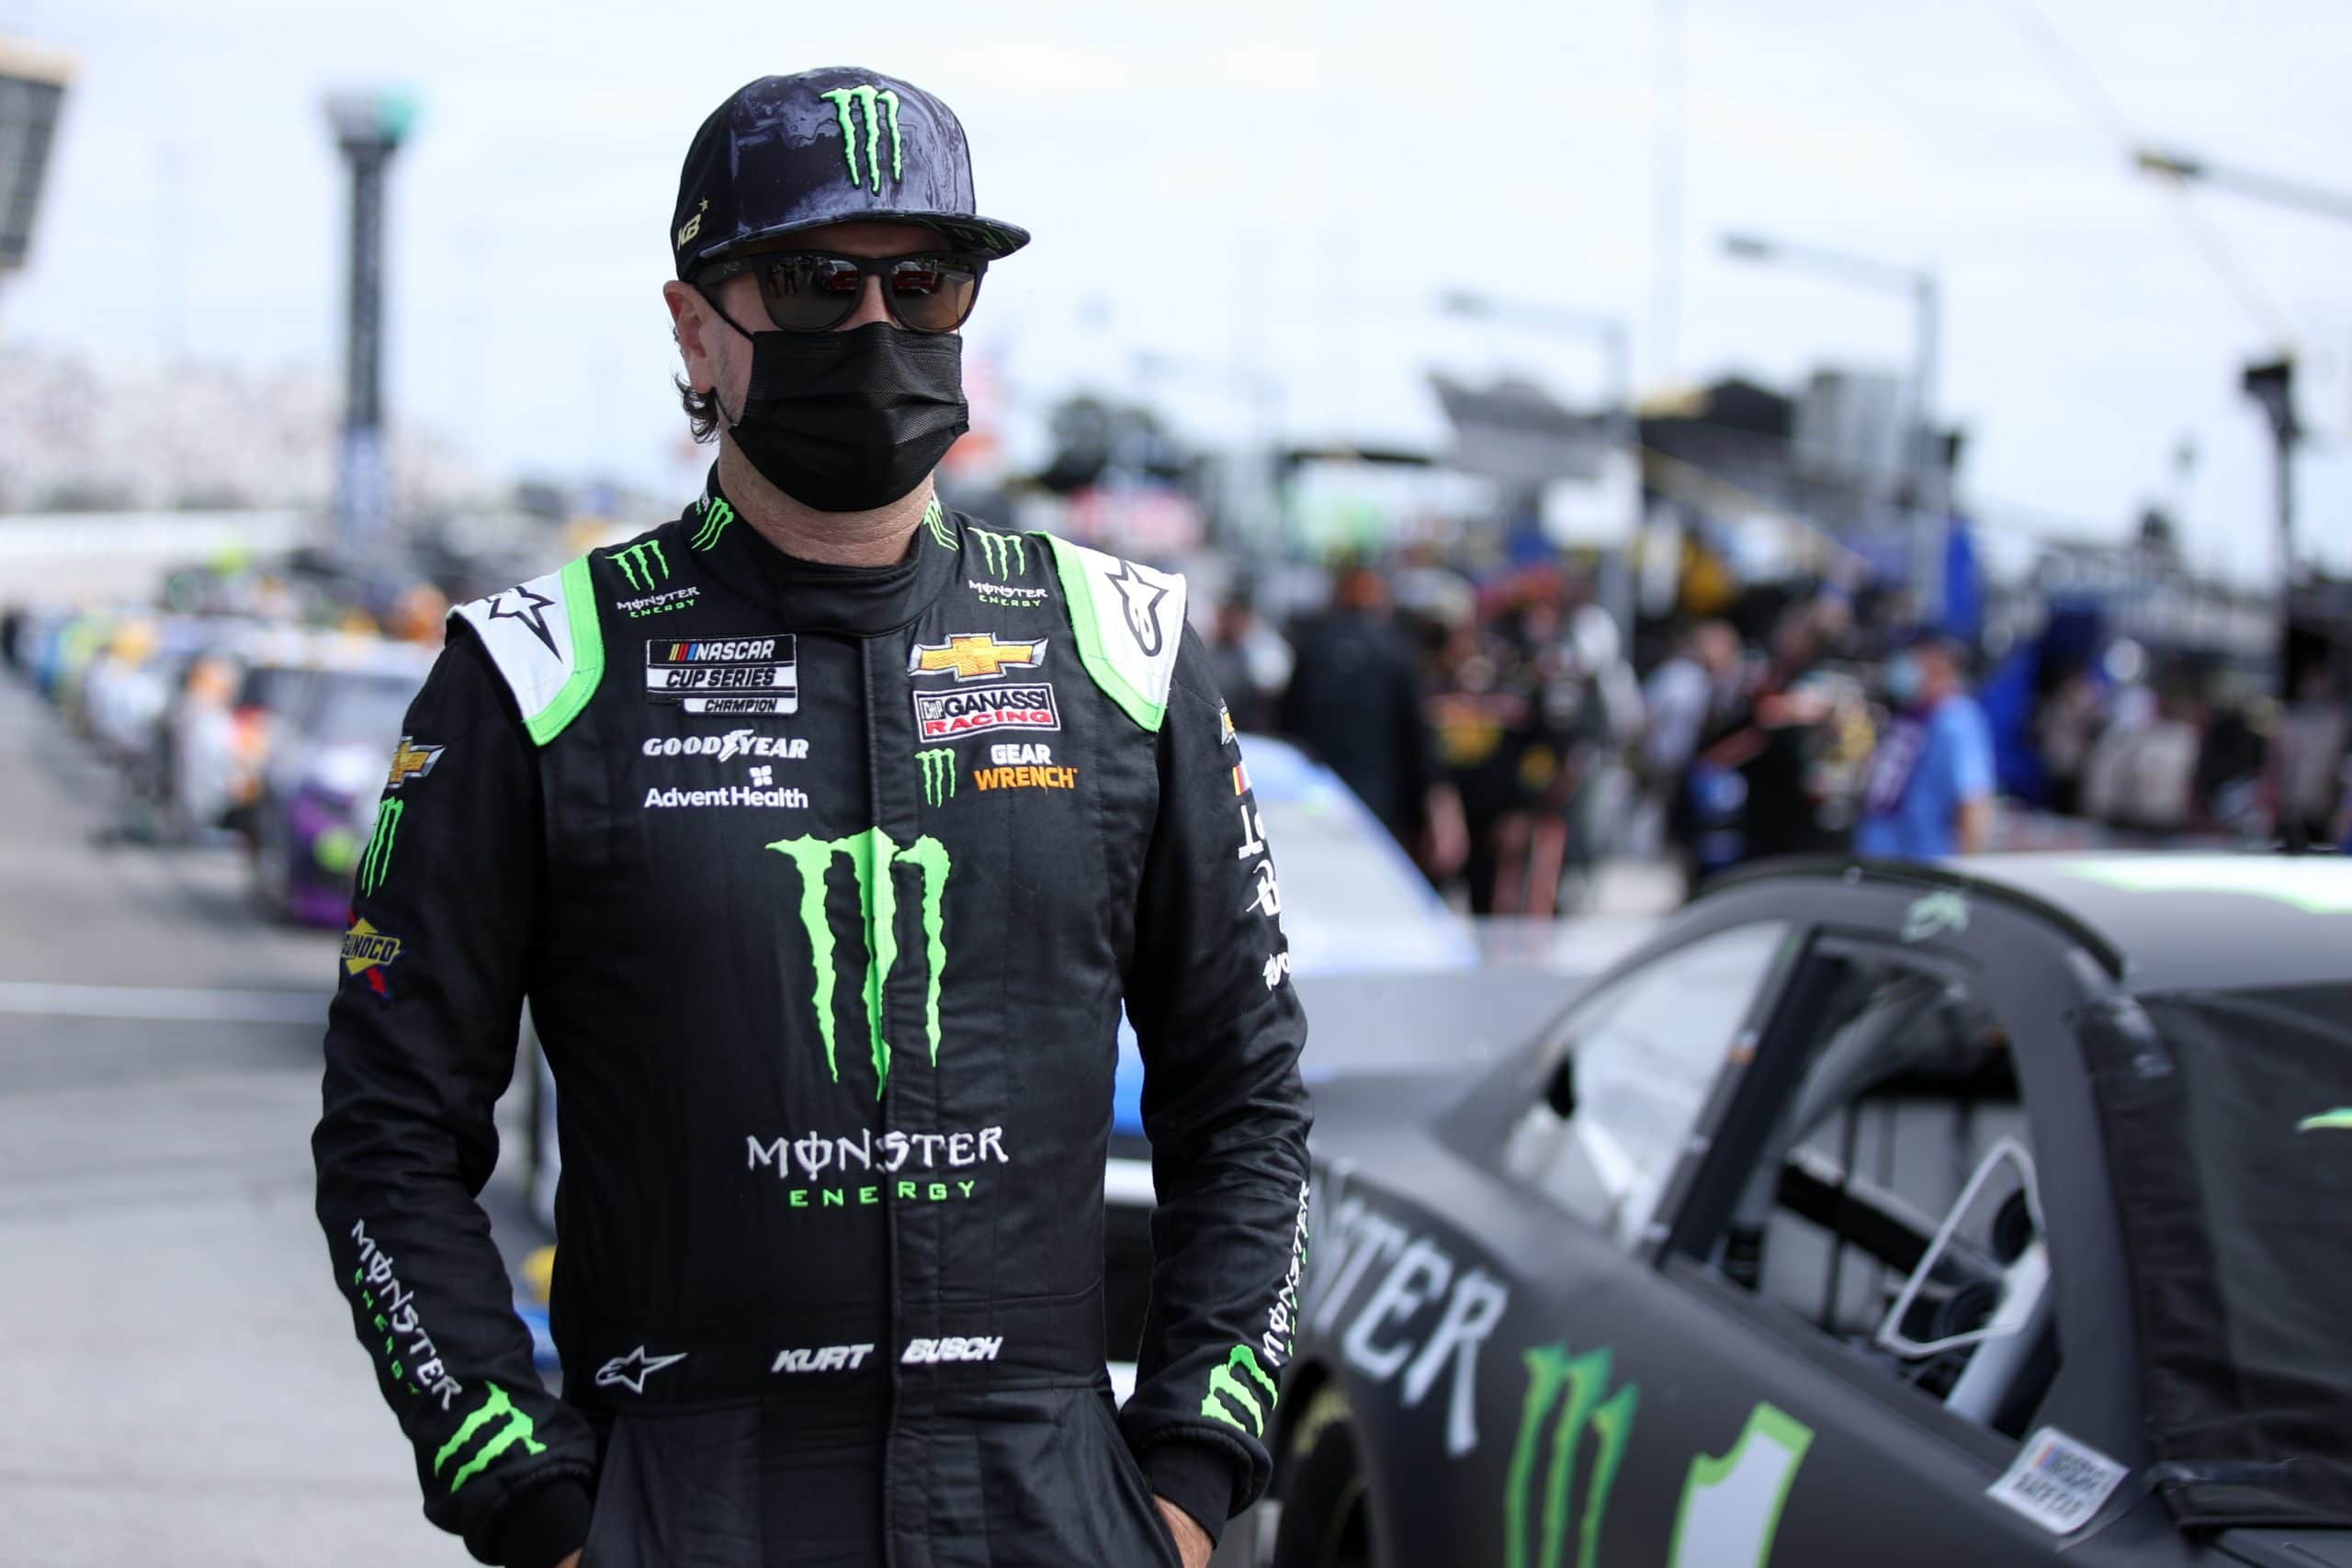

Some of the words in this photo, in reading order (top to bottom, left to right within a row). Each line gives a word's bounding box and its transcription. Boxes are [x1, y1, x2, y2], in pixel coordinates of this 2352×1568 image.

[616, 585, 700, 611] MONSTER
[968, 580, 1048, 598] MONSTER
[978, 595, 1041, 607] ENERGY
[630, 599, 695, 617] ENERGY
[694, 638, 775, 662] NASCAR
[665, 669, 706, 688] CUP
[707, 668, 777, 686] SERIES
[704, 698, 778, 713] CHAMPION
[944, 690, 1047, 717] GANASSI
[925, 710, 1053, 734] RACING
[643, 729, 809, 762] GOODYEAR
[990, 743, 1053, 765] GEAR
[973, 766, 1078, 792] WRENCH
[644, 786, 809, 808] AdventHealth
[746, 1126, 1009, 1181] MONSTER
[789, 1180, 975, 1207] ENERGY
[351, 1218, 462, 1411] MONSTER
[771, 1343, 875, 1372] KURT
[900, 1337, 1003, 1364] BUSCH
